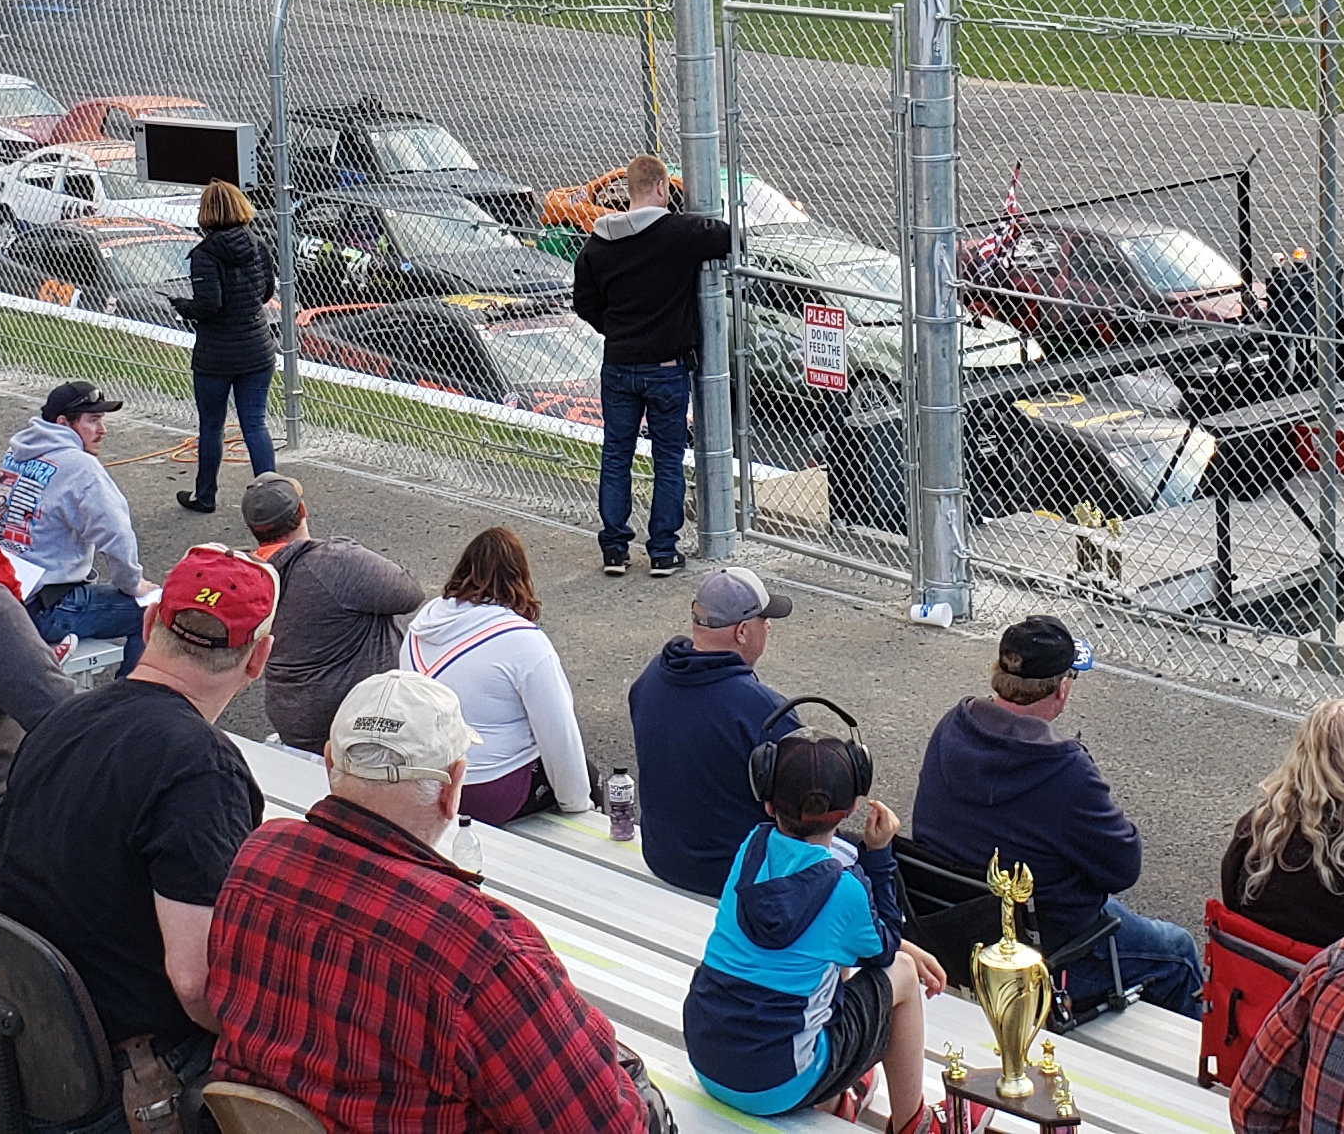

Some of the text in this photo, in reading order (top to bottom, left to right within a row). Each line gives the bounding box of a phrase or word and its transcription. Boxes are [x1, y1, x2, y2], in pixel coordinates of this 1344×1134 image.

[807, 308, 843, 327] PLEASE
[811, 328, 838, 343] DO NOT
[809, 341, 841, 356] FEED THE
[811, 355, 840, 370] ANIMALS
[809, 370, 843, 387] THANK YOU
[195, 588, 222, 607] 24
[88, 656, 98, 666] 15
